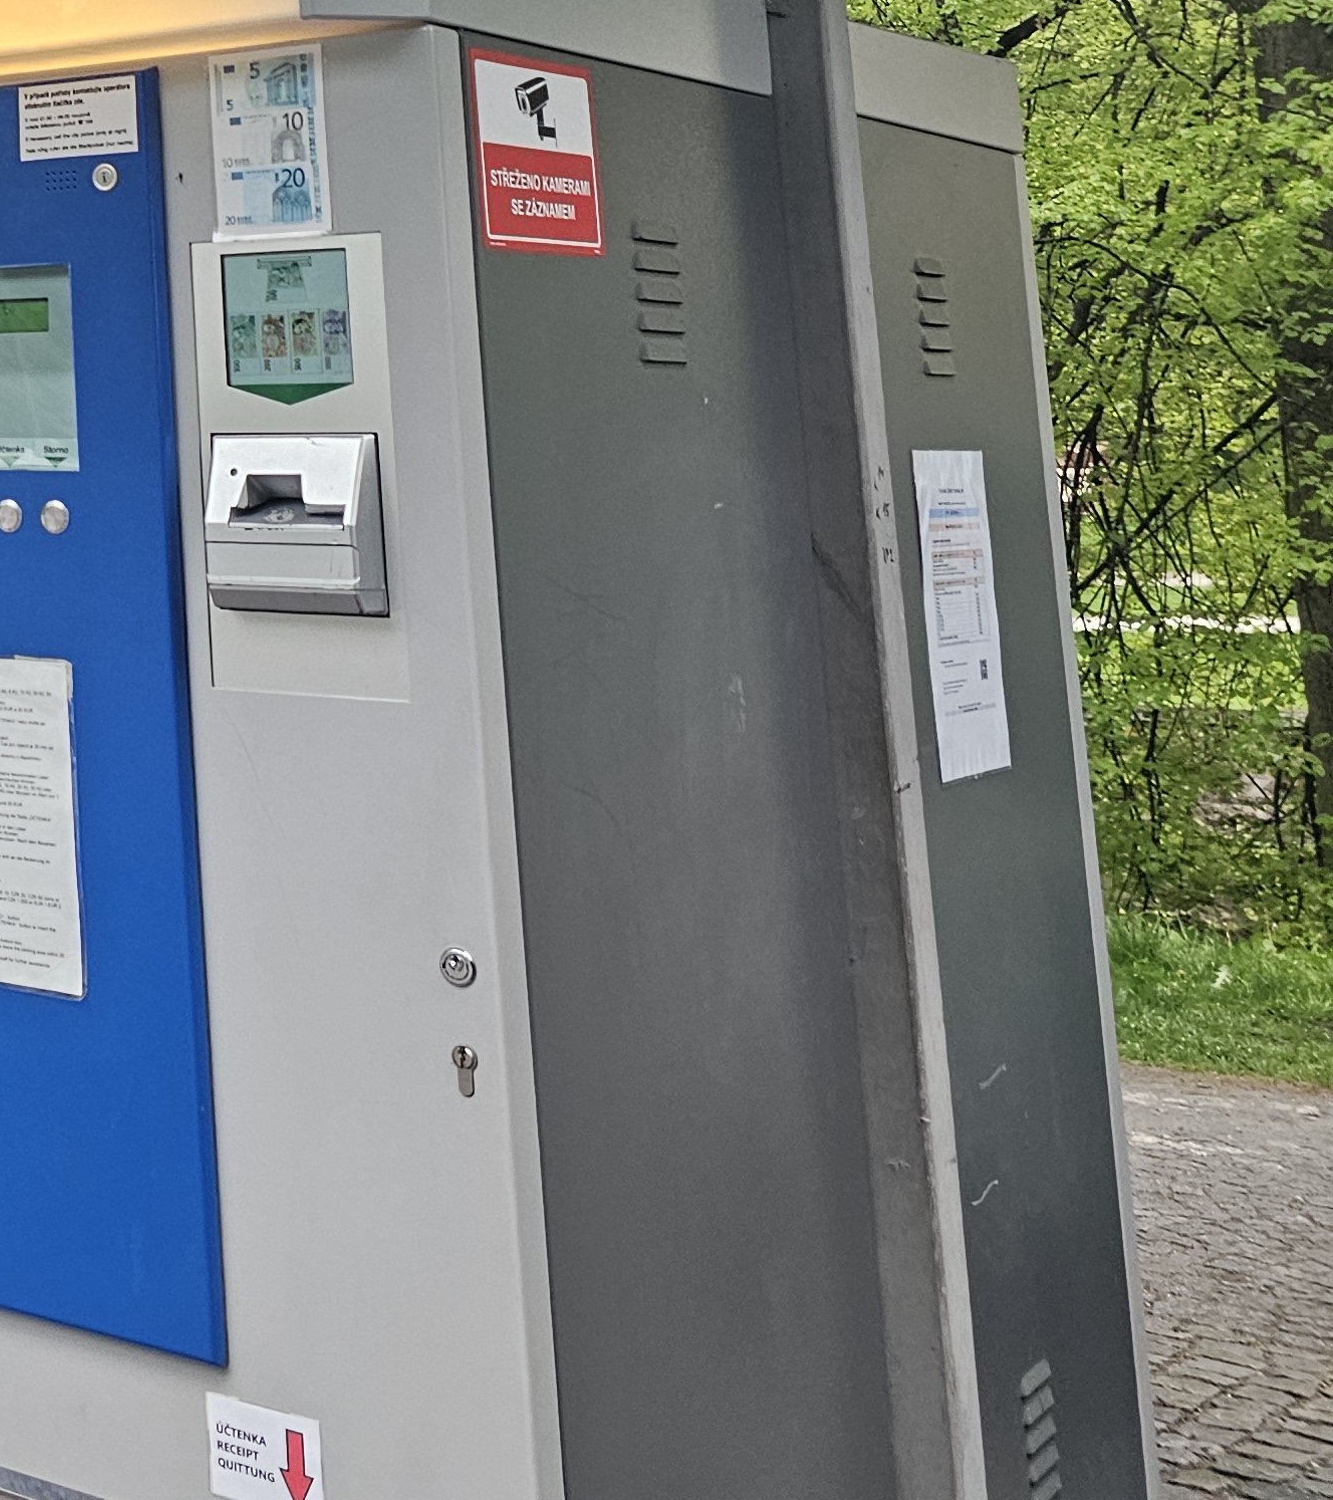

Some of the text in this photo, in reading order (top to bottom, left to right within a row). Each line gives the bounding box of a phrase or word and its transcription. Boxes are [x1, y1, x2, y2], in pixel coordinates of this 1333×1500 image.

[249, 62, 261, 79] 5
[226, 100, 234, 111] 5
[283, 111, 304, 131] 10
[282, 168, 305, 188] 20
[490, 167, 592, 197] STŘEŽENO KAMERAMI
[511, 198, 576, 220] SE ZÁZNAMEM
[225, 216, 236, 226] 20
[44, 445, 69, 454] Storno
[216, 1420, 267, 1447] ÚČTENKA
[217, 1440, 259, 1461] RECEIPT
[218, 1457, 275, 1483] QUITTUNG
